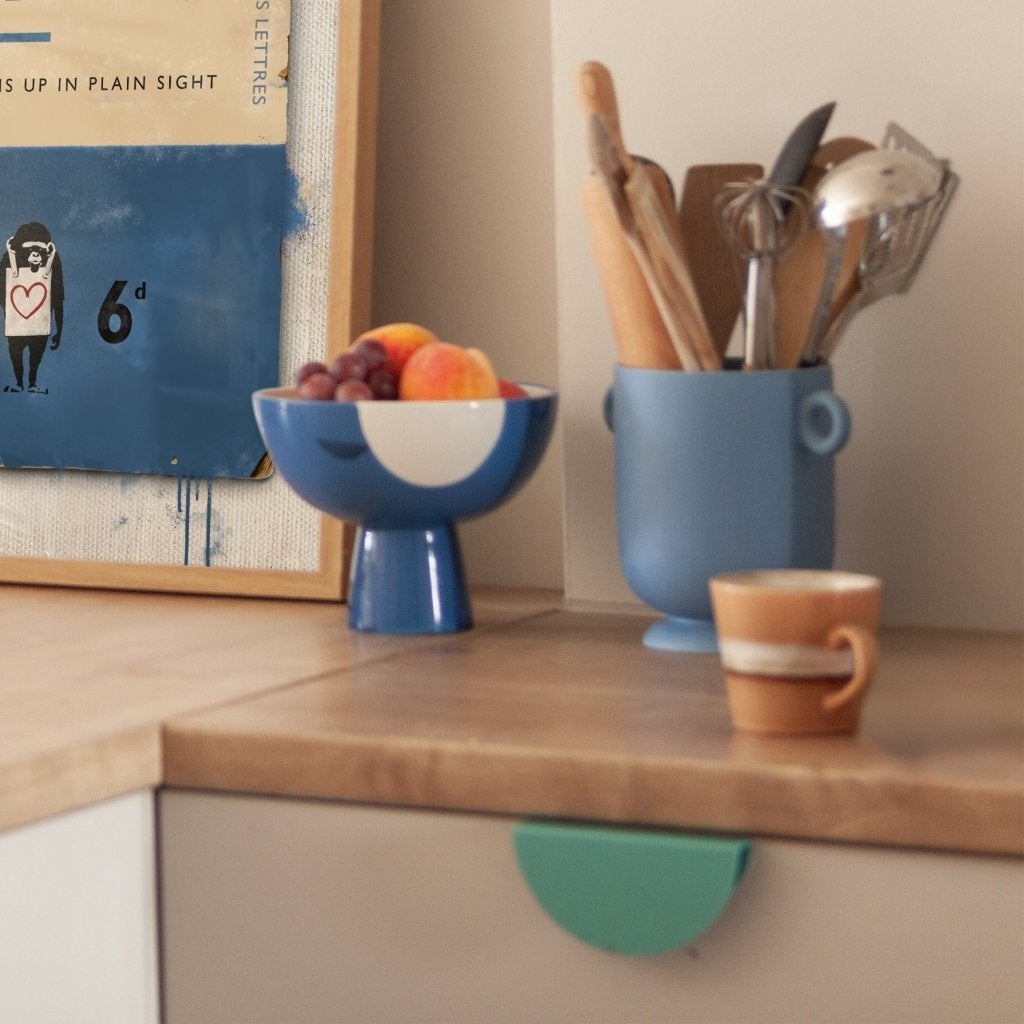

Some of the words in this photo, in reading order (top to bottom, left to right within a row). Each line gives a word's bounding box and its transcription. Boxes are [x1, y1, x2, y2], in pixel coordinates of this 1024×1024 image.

[23, 78, 48, 93] UP
[57, 77, 78, 92] IN
[88, 76, 146, 91] PLAIN
[156, 74, 218, 91] SIGHT
[252, 19, 269, 106] LETTRES
